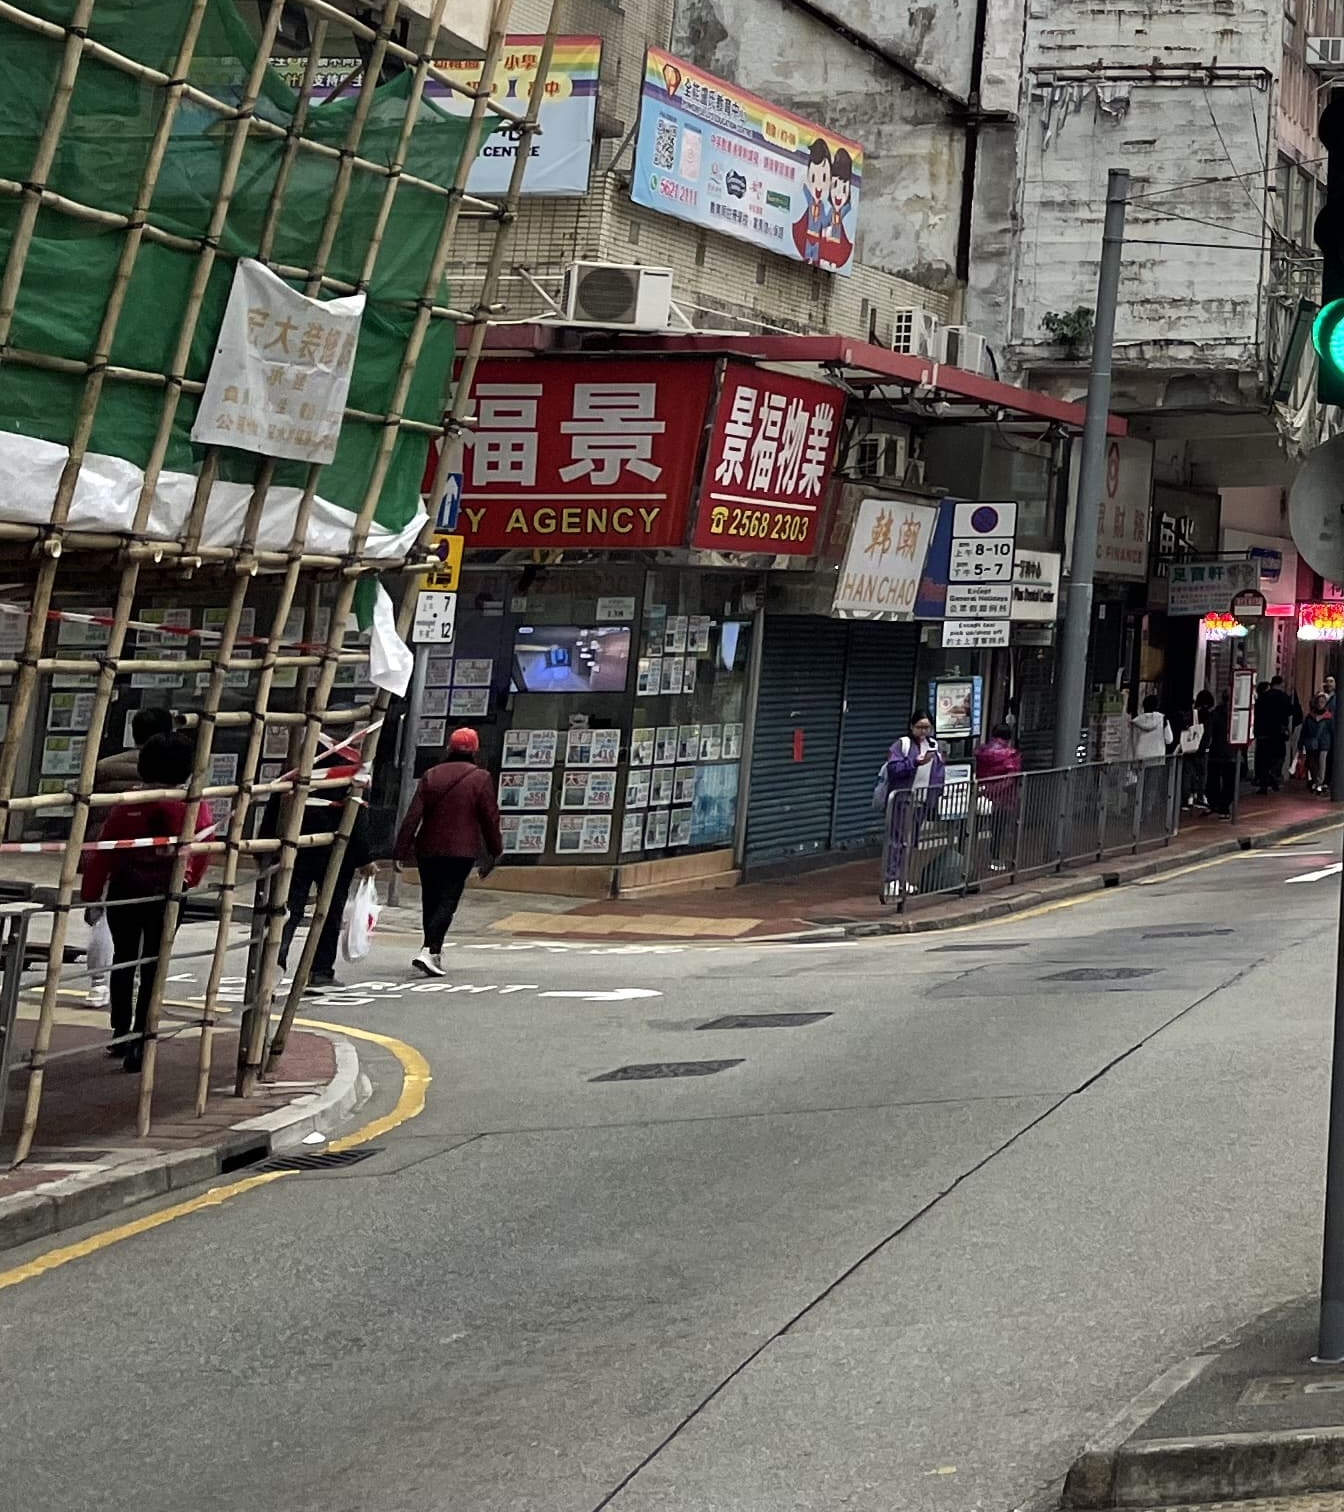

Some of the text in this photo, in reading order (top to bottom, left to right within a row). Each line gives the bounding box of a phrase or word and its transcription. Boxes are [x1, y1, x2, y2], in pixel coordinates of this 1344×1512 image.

[714, 384, 835, 499] 景福物業
[506, 507, 661, 534] AGENCY
[729, 508, 809, 542] 2568 2303
[975, 543, 1011, 556] 8-10
[974, 563, 1003, 576] 5-7
[841, 572, 916, 605] HAN CHAO
[444, 595, 451, 613] 7
[441, 622, 452, 639] 12
